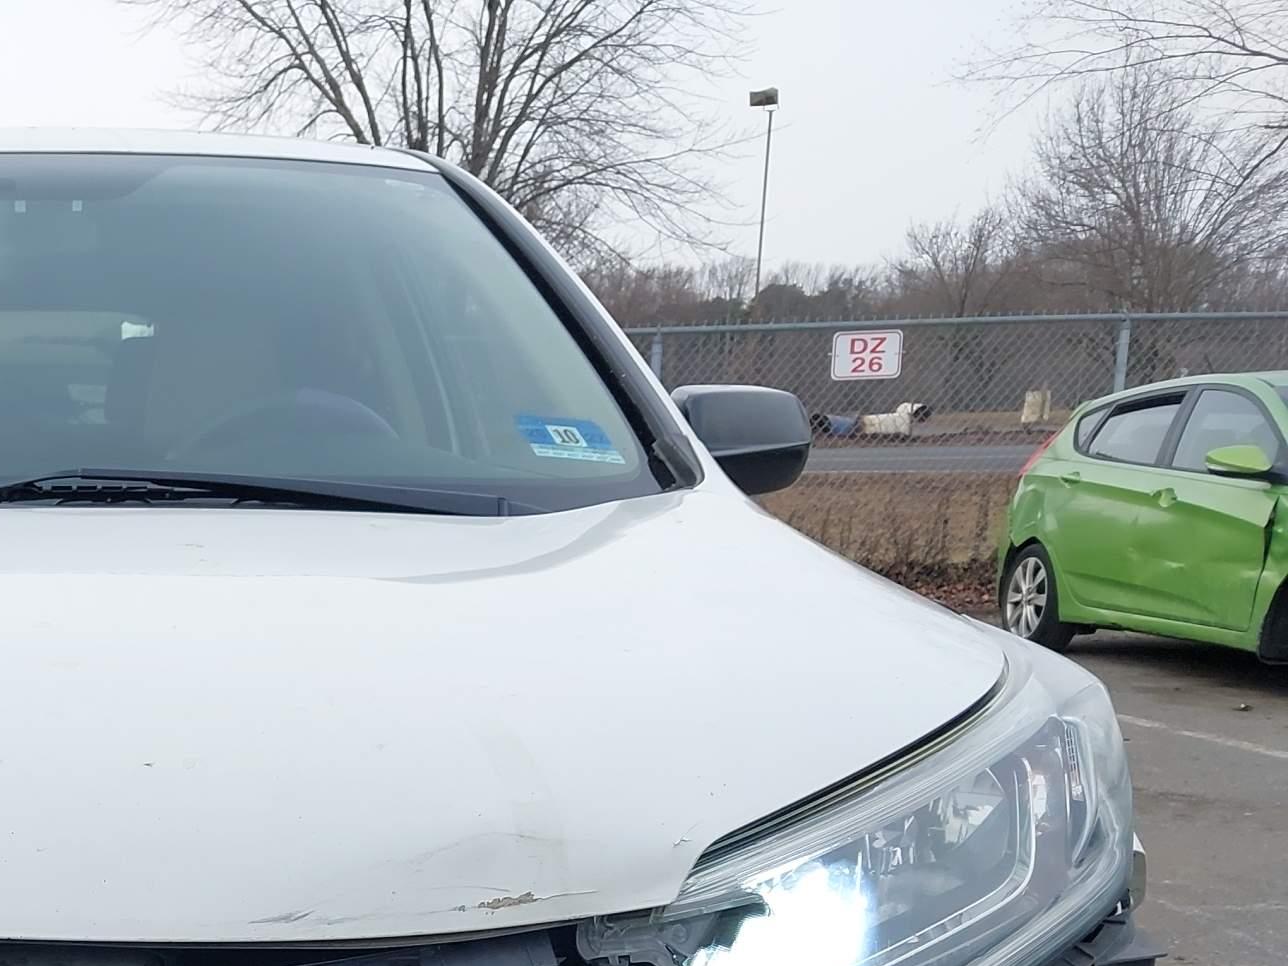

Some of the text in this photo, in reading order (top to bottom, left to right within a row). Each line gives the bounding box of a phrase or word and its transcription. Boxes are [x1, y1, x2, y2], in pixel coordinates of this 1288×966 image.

[850, 336, 887, 355] DZ
[850, 356, 883, 373] 26
[552, 428, 581, 445] 10
